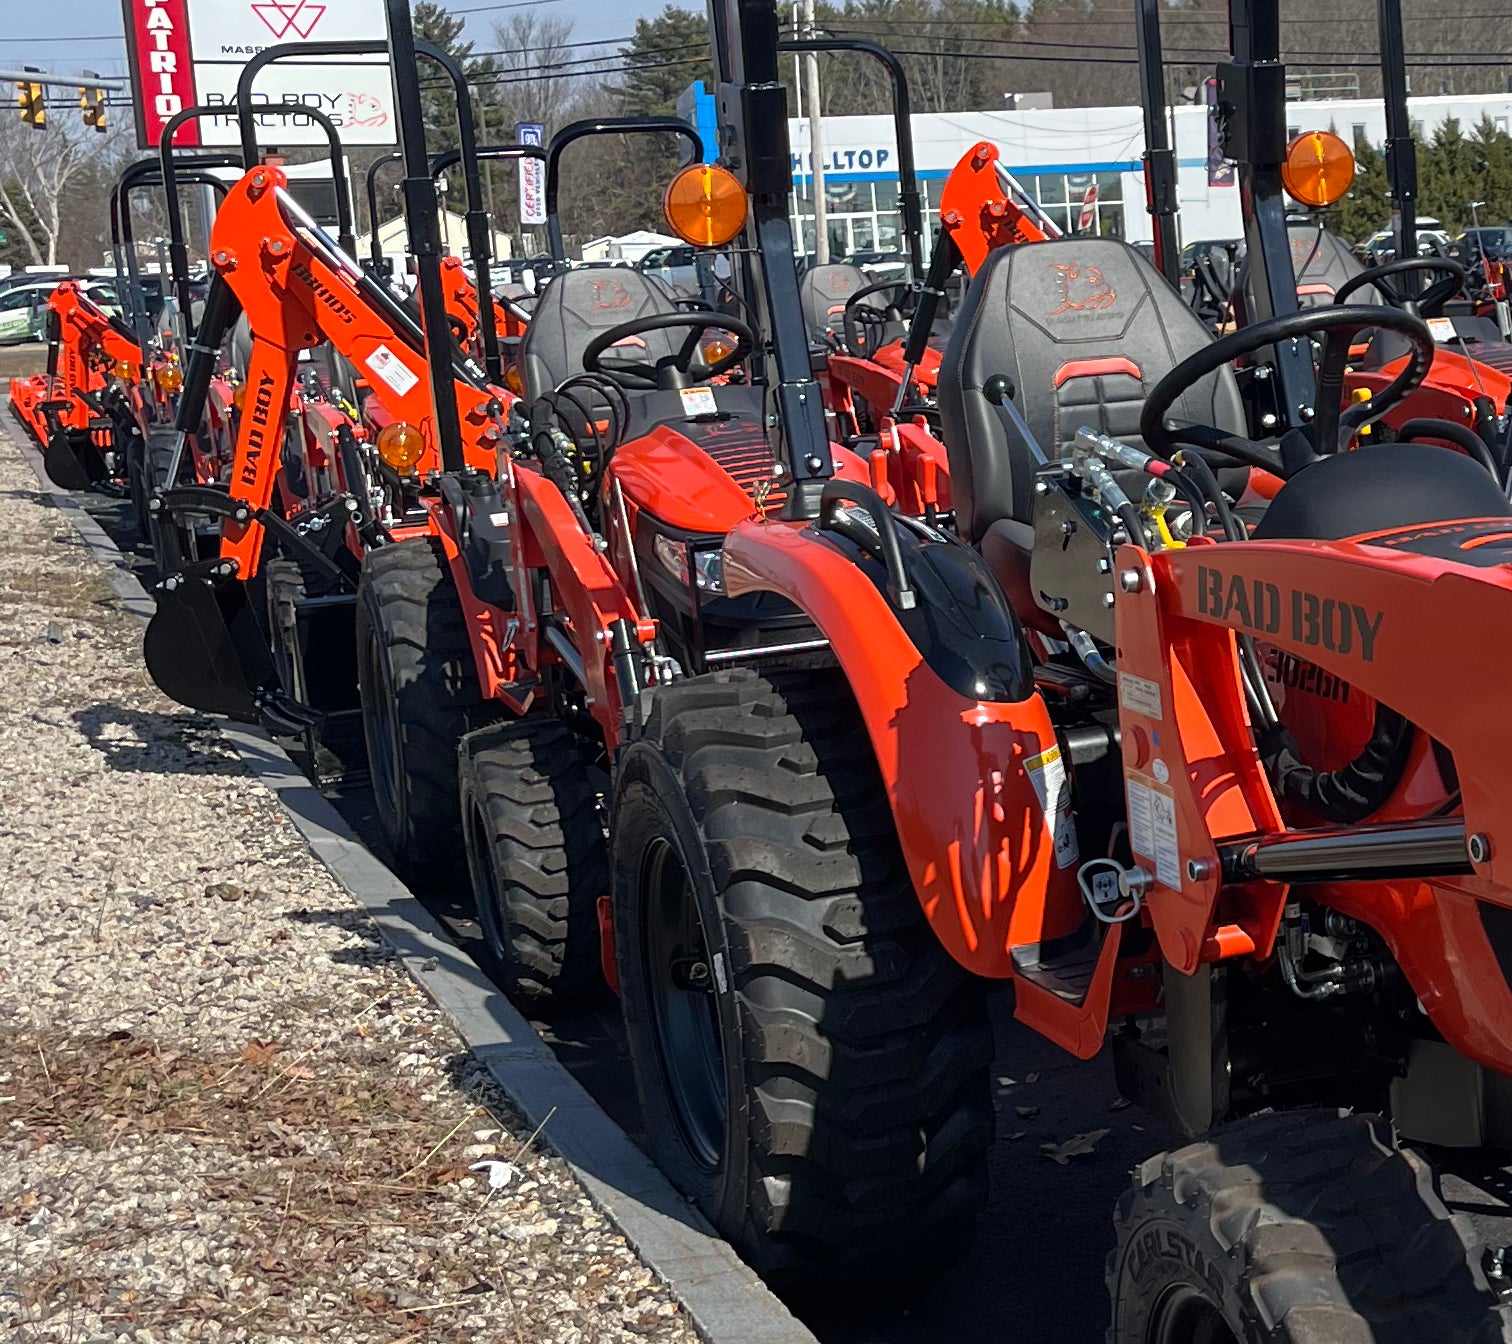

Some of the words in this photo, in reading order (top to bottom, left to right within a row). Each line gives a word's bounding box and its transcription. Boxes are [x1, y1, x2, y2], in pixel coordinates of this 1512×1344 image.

[282, 93, 342, 110] BOY
[241, 430, 265, 486] BAD
[253, 369, 275, 426] BOY
[1198, 566, 1281, 634] BAD
[1292, 589, 1384, 662] BOY
